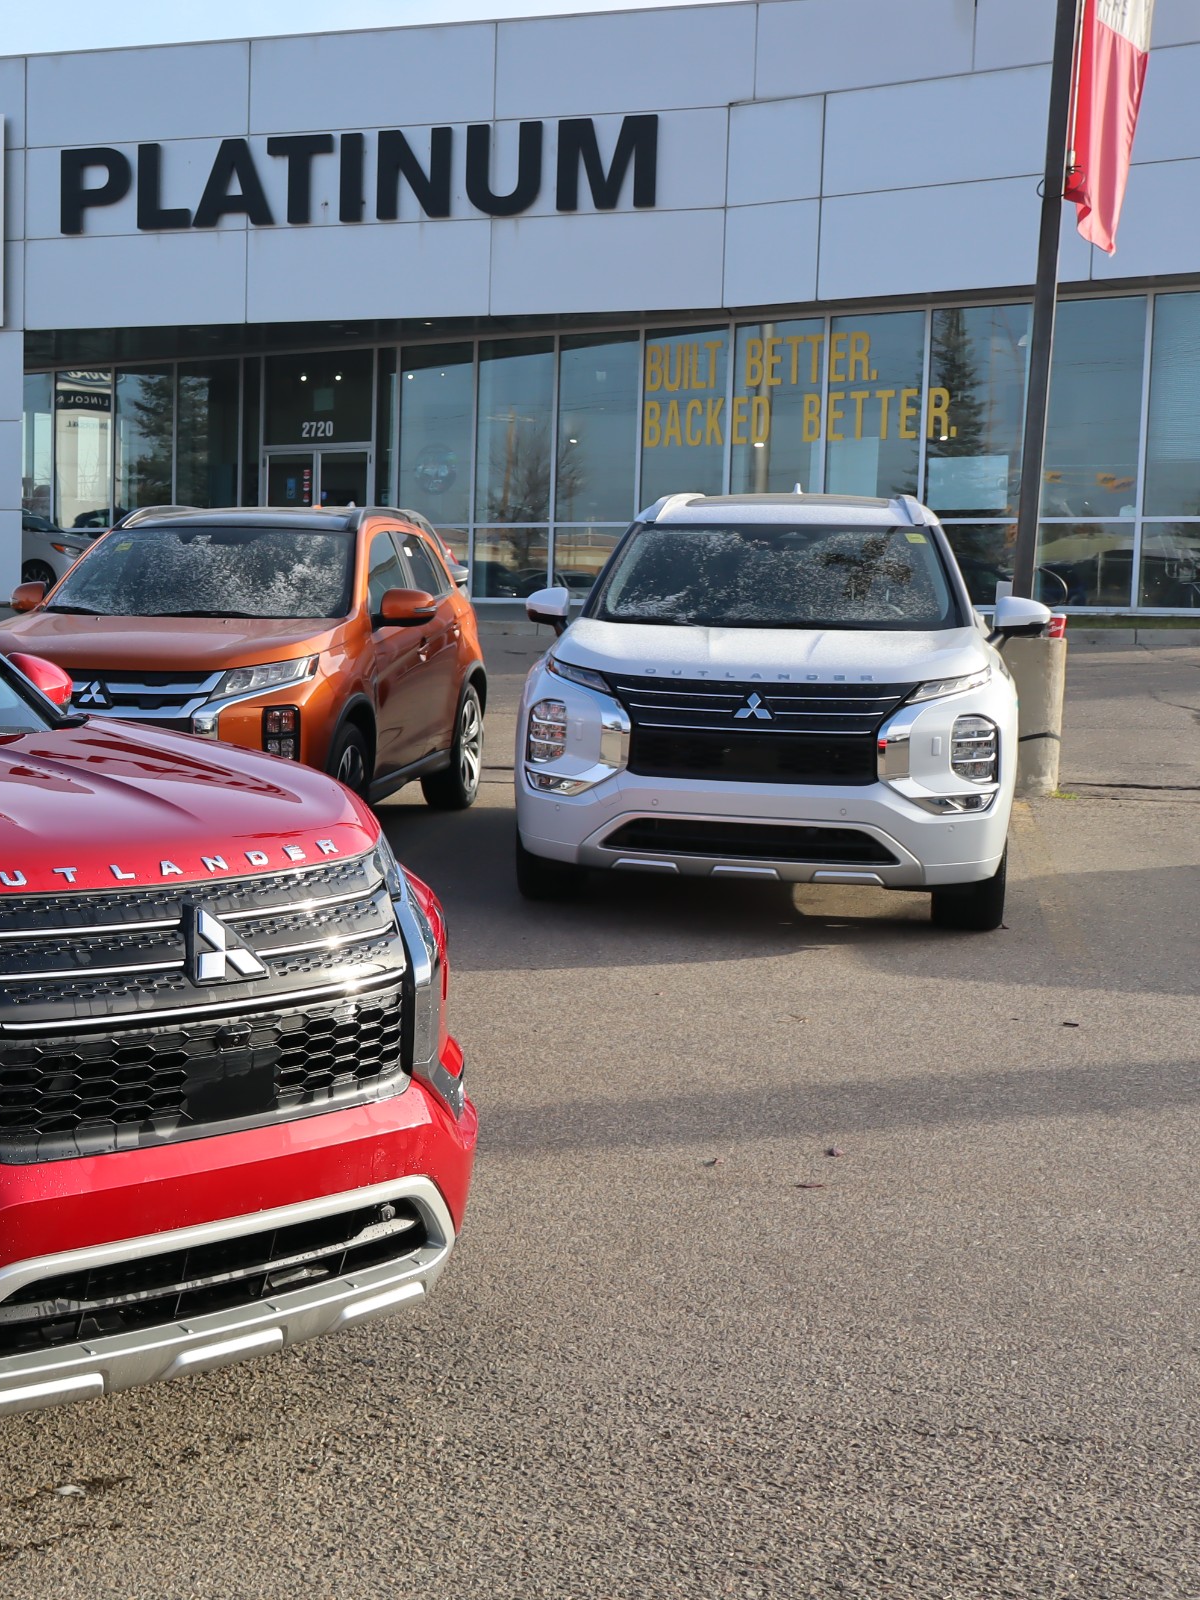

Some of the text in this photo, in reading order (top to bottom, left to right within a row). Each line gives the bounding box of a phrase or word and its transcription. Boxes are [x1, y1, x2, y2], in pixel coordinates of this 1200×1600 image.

[59, 113, 659, 235] PLATINUM
[645, 331, 878, 392] BUILT BETTER.
[302, 421, 334, 438] 2720
[643, 387, 957, 448] BACKED BETTER.
[645, 668, 875, 682] OUTLANDER
